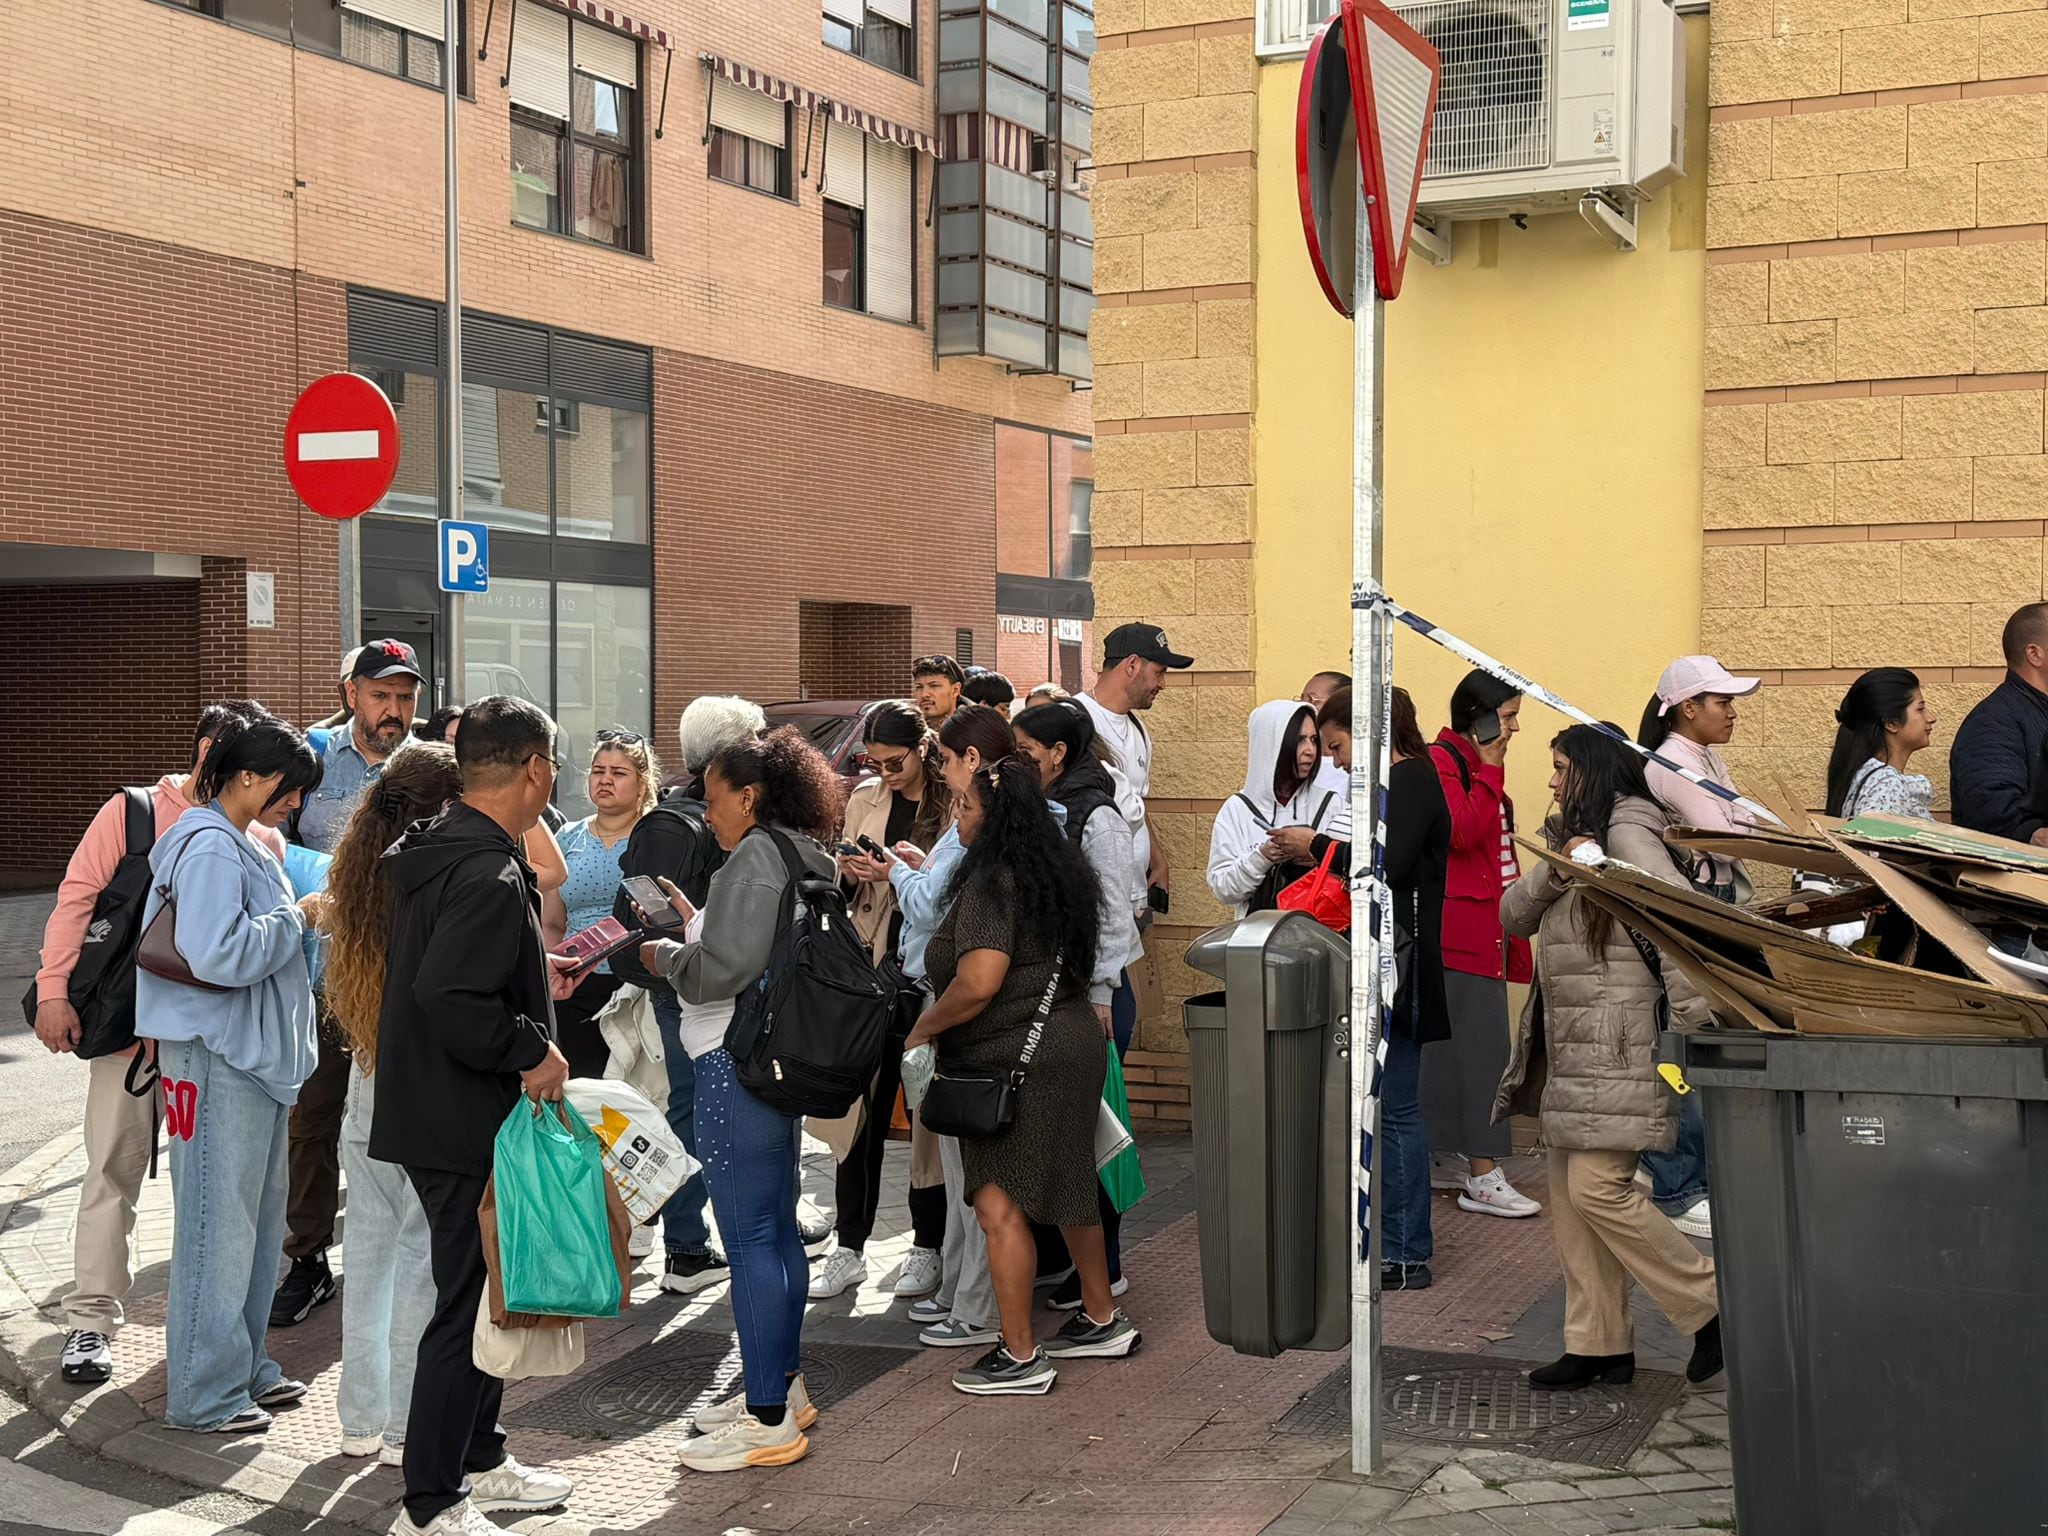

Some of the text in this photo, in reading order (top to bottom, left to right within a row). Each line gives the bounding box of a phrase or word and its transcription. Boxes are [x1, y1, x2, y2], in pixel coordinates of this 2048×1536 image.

[448, 528, 477, 583] P
[383, 642, 408, 664] NY
[1498, 664, 1533, 688] Madrid
[1020, 1021, 1045, 1064] BIMBA
[1038, 972, 1060, 1015] BIMBA
[1367, 1016, 1377, 1054] Madrid
